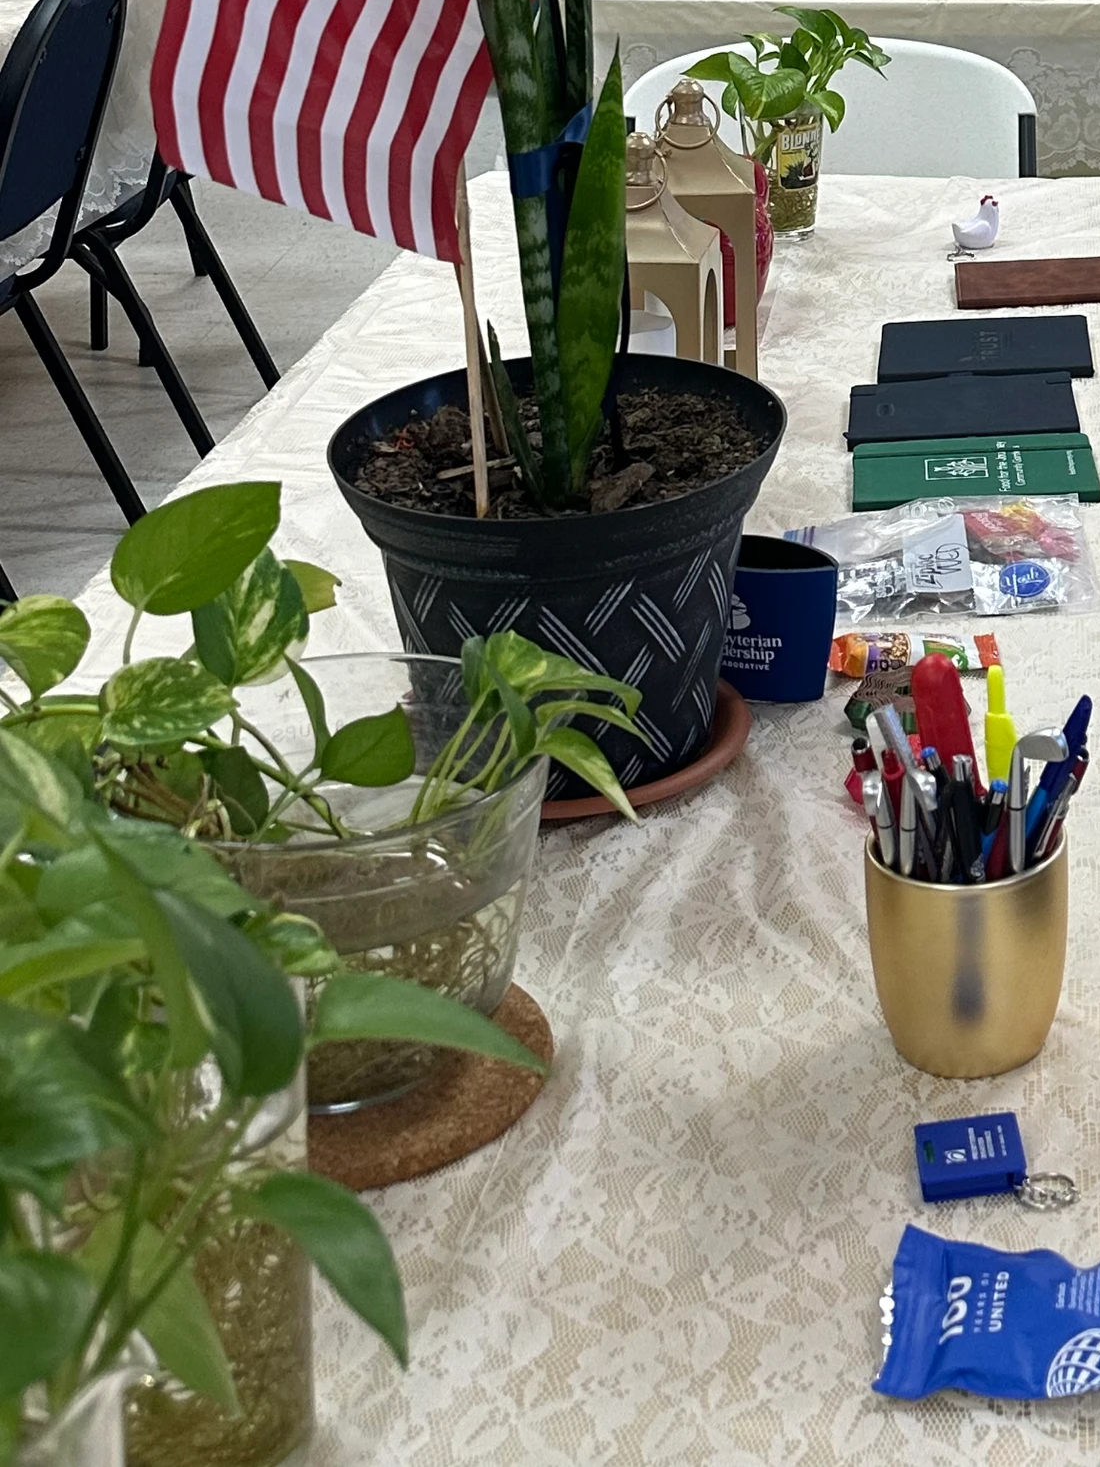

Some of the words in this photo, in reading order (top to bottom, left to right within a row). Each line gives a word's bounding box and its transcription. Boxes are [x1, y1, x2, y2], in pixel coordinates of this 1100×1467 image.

[999, 478, 1011, 492] Food
[939, 1276, 972, 1345] 100
[973, 1292, 987, 1333] YEARS
[988, 1271, 1010, 1333] UNITED
